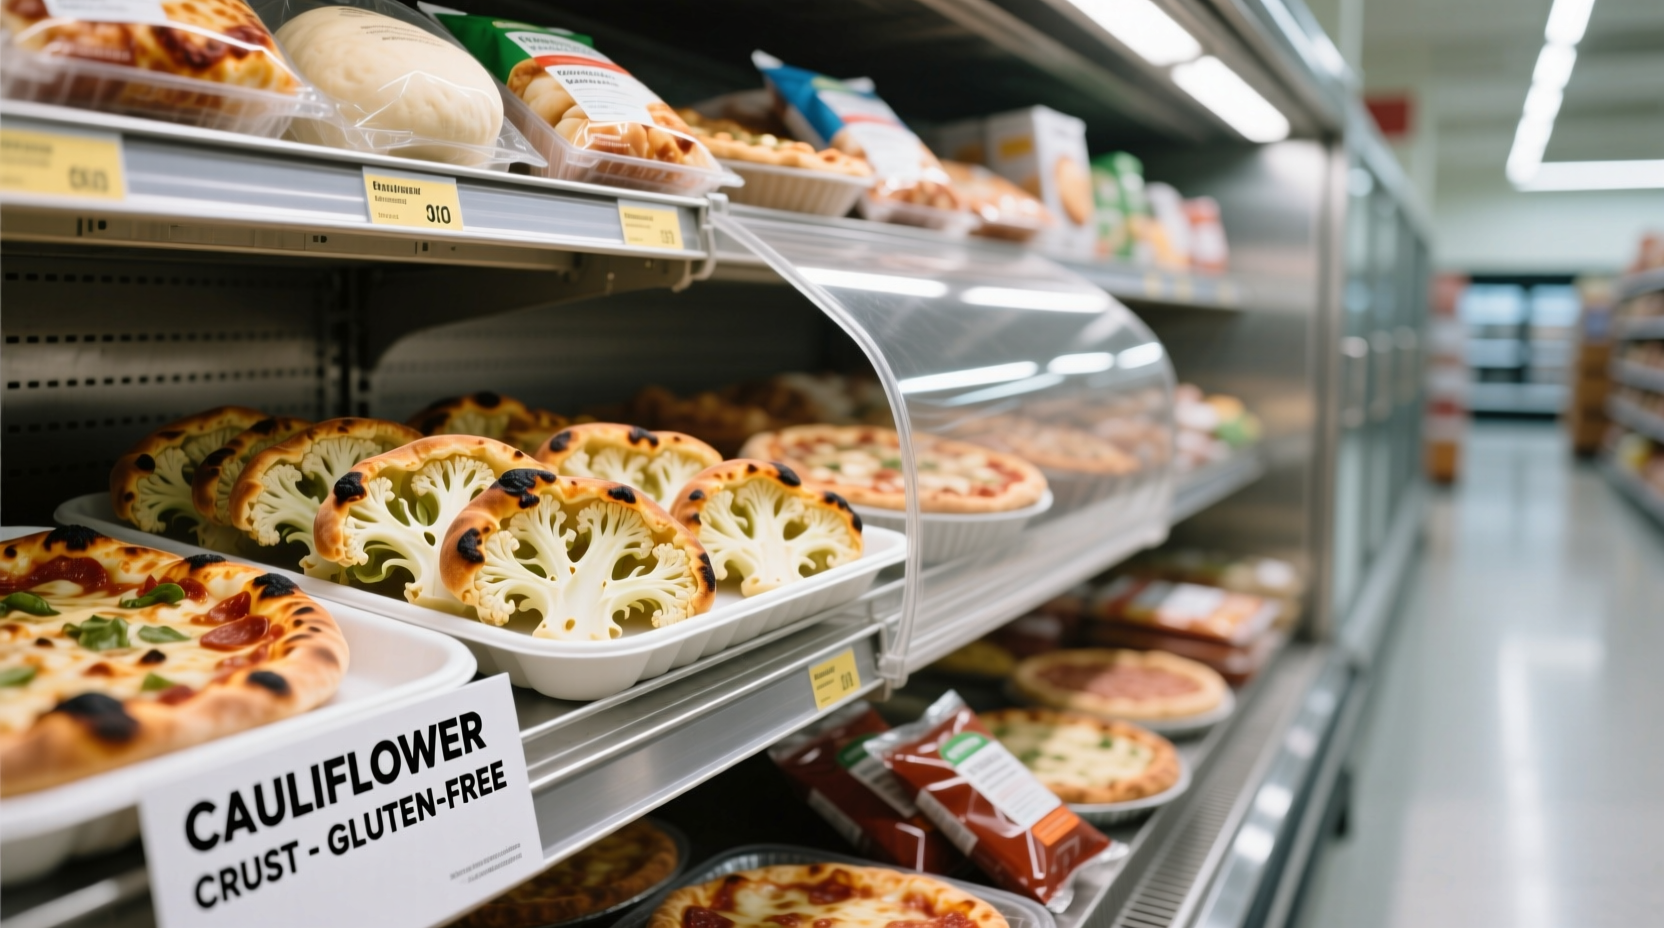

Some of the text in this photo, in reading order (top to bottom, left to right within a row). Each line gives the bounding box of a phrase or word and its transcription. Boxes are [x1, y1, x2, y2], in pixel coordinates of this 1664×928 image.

[184, 711, 487, 852] CAULIFLOWER
[194, 840, 299, 910] CRUST
[327, 759, 508, 856] GLUTEN-FREE
